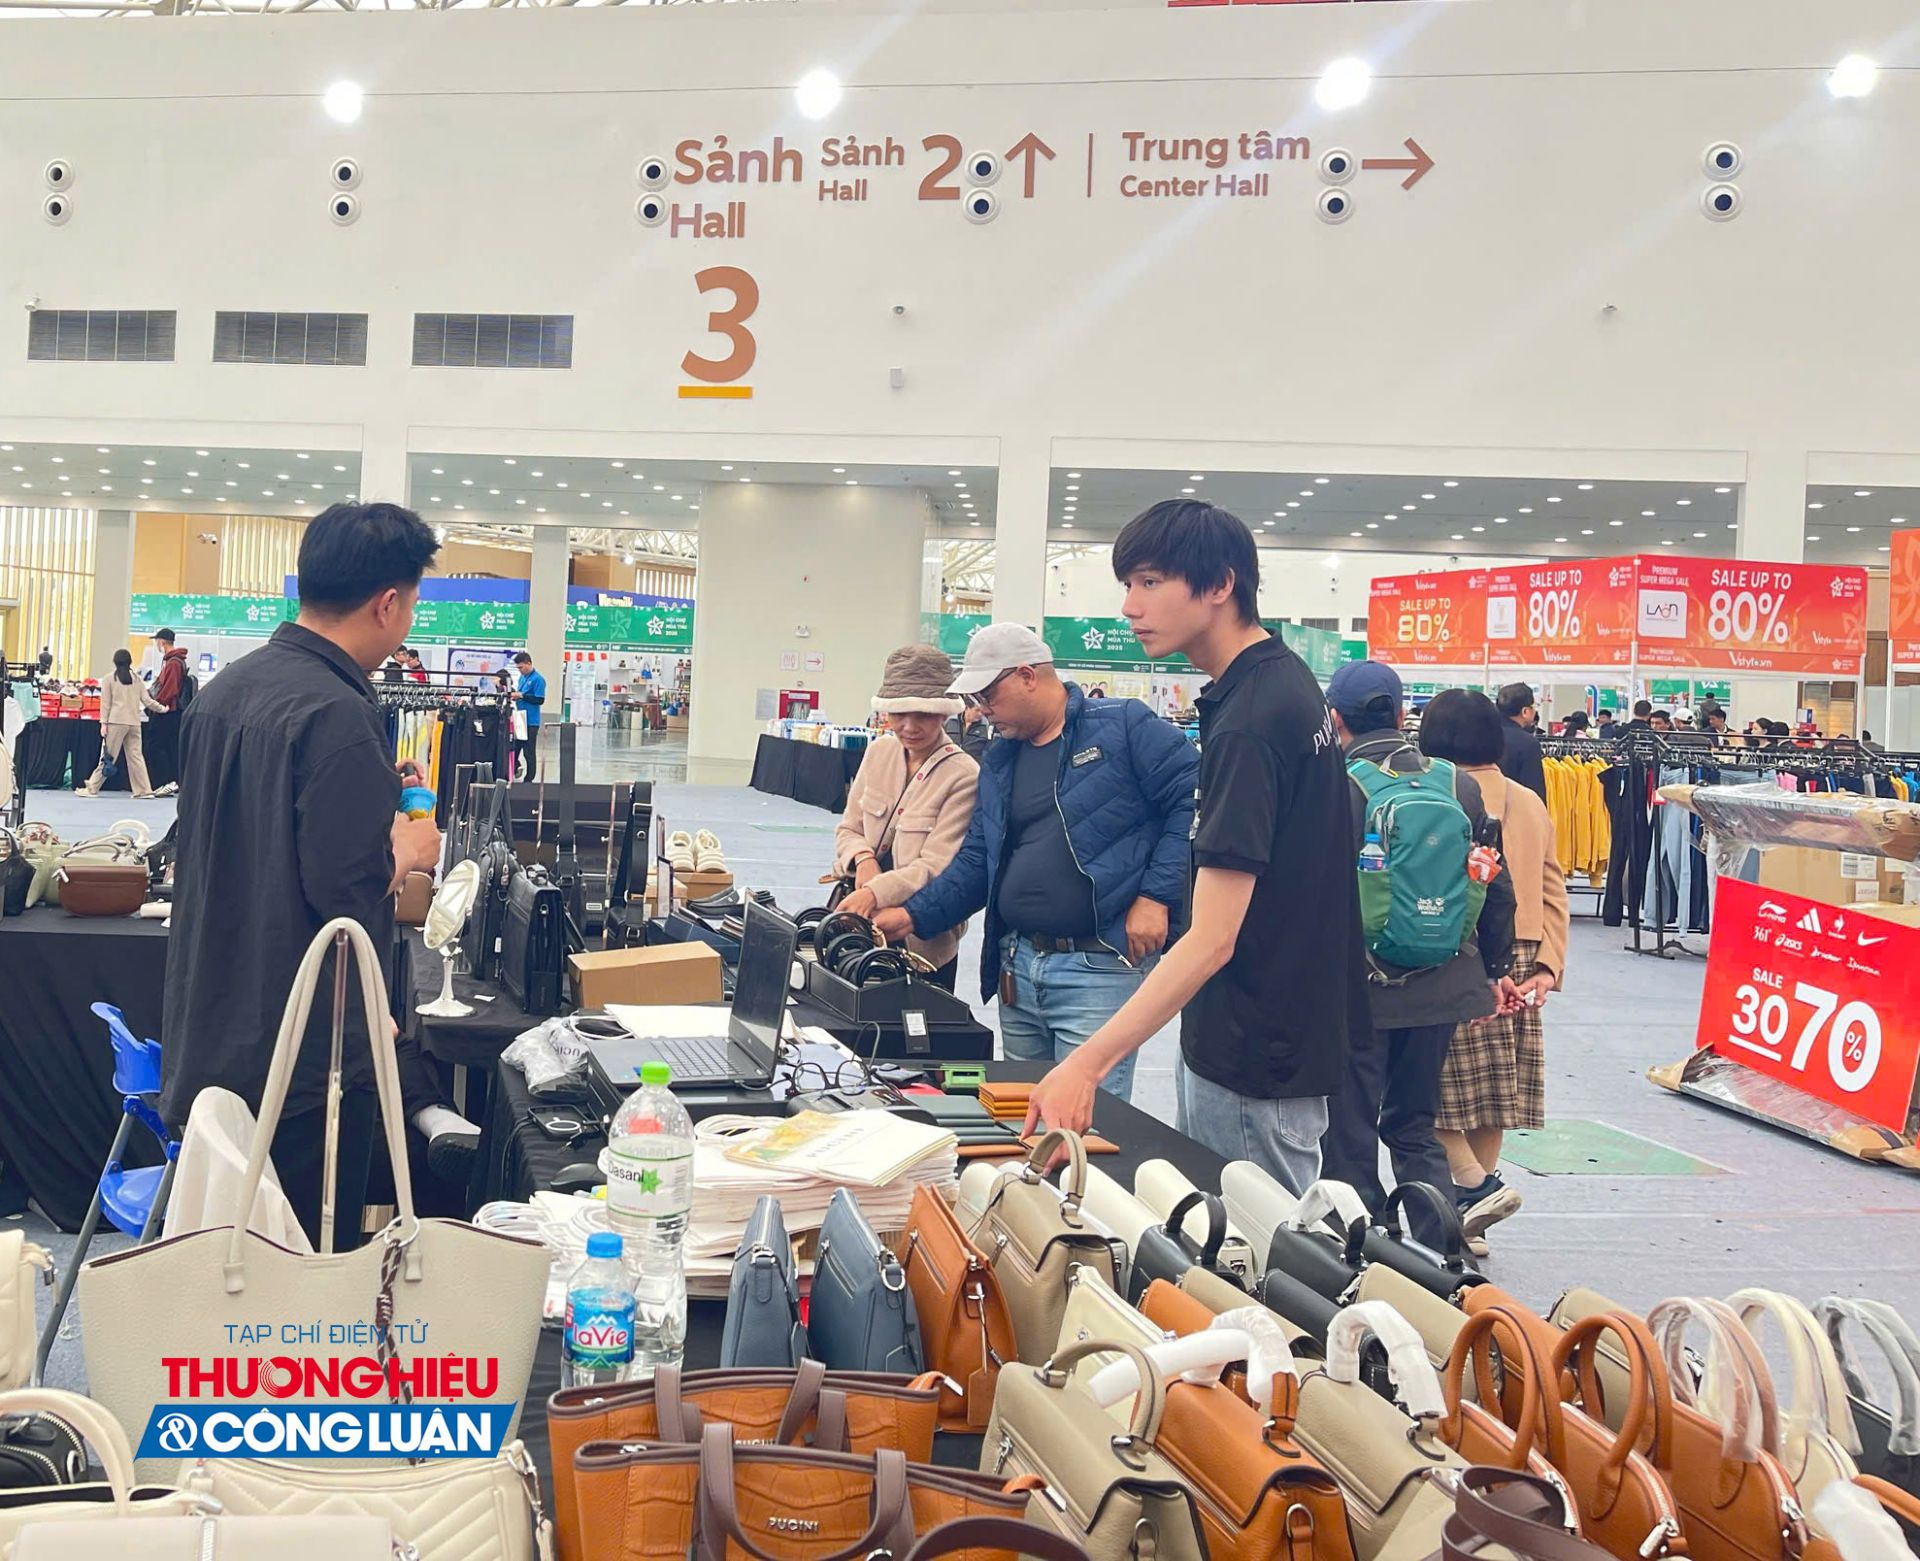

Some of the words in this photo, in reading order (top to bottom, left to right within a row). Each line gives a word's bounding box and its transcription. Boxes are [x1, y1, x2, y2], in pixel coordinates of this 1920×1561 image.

[673, 135, 803, 184] Sảnh
[821, 136, 905, 167] Sảnh
[1122, 131, 1229, 169] Trung
[1238, 130, 1311, 160] tâm
[918, 134, 964, 200] 2
[819, 179, 868, 201] Hall
[1120, 175, 1210, 197] Center
[1215, 174, 1269, 196] Hall
[670, 202, 746, 238] Hall
[680, 266, 760, 384] 3
[1529, 571, 1553, 588] SALE
[1554, 570, 1567, 587] UP
[1569, 569, 1582, 585] TO
[1711, 569, 1747, 588] SALE
[1750, 571, 1770, 589] UP
[1773, 572, 1792, 590] TO
[1400, 600, 1422, 611] SALE
[1423, 599, 1437, 610] UP
[1438, 597, 1451, 609] TO
[1528, 590, 1581, 638] 80%
[1708, 590, 1789, 644] 80%
[1398, 613, 1450, 642] 80%
[1729, 651, 1772, 668] Vstyle.vn
[1753, 967, 1783, 989] SALE
[1731, 984, 1789, 1045] 30
[1790, 981, 1882, 1093] 70
[573, 1323, 627, 1347] laVie
[768, 1516, 819, 1533] PUCINI
